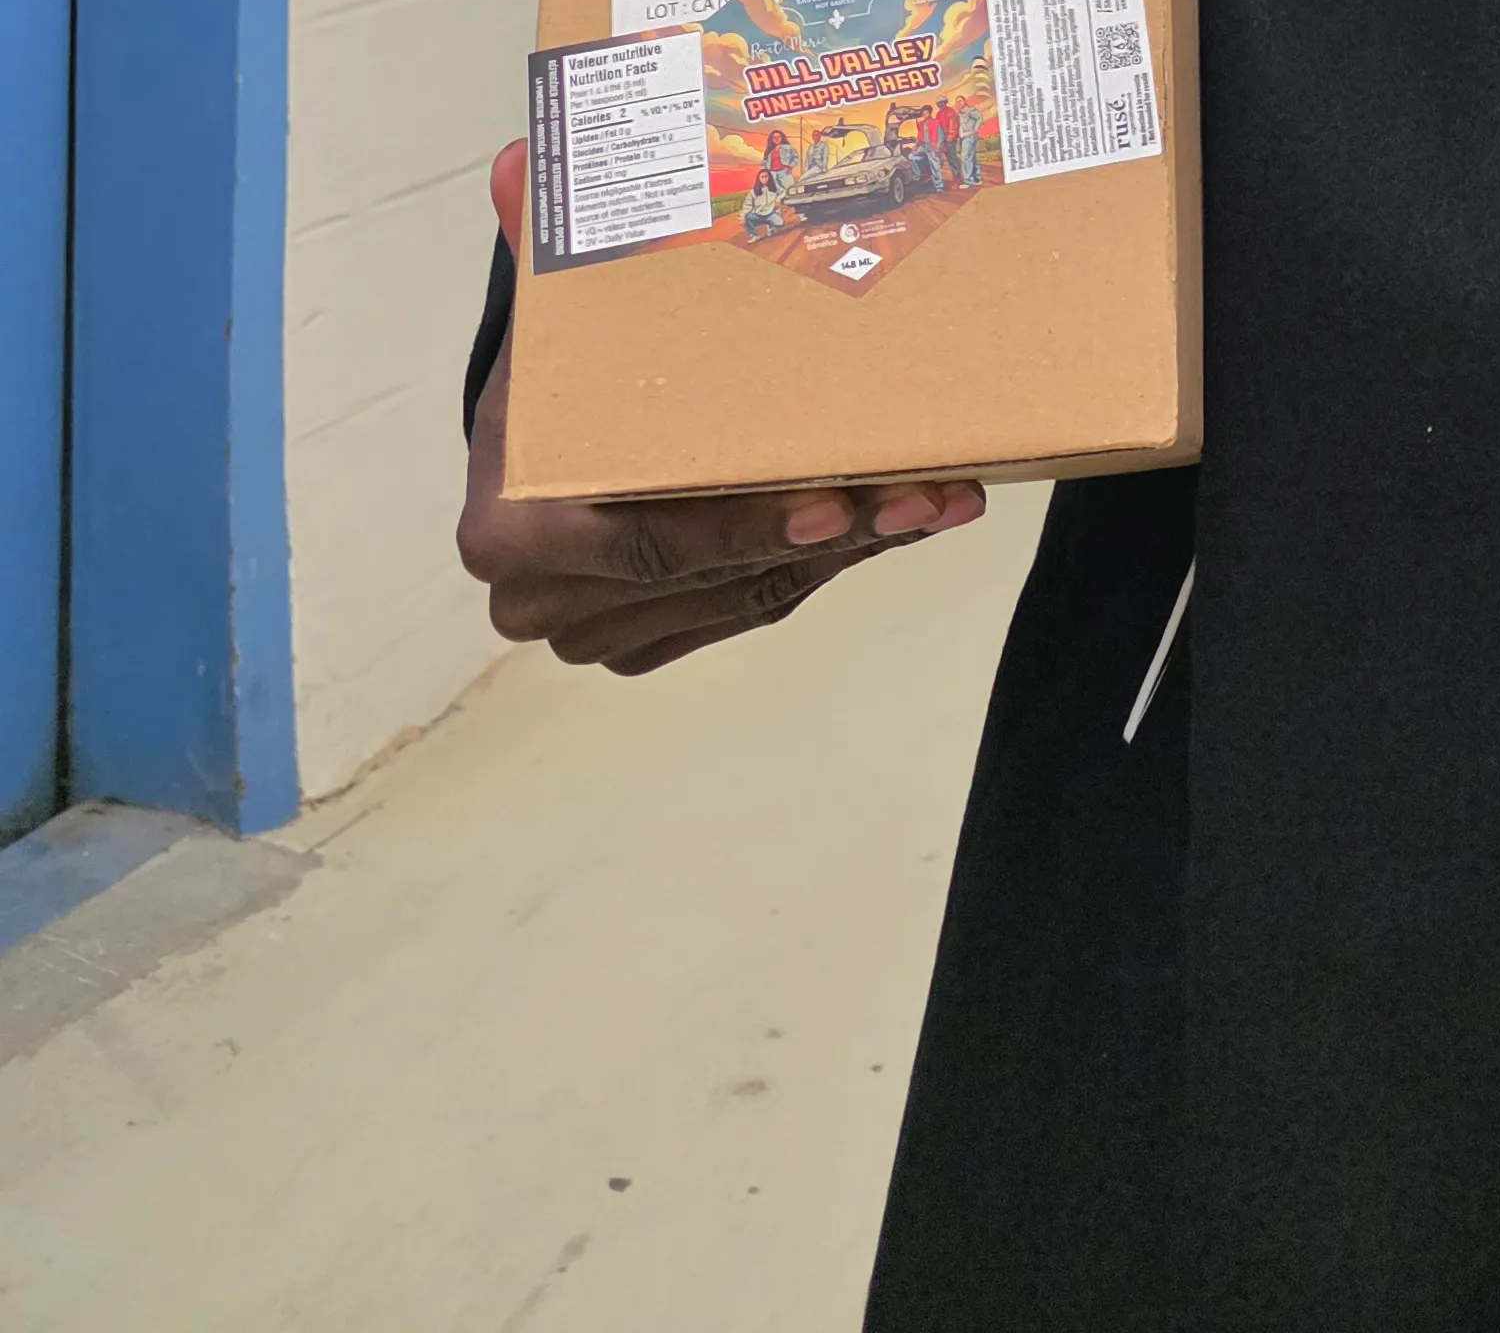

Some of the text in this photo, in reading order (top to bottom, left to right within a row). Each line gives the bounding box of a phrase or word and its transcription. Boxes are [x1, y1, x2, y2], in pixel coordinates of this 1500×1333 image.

[646, 2, 679, 20] LOT
[568, 42, 662, 70] Valeur nutritive
[745, 35, 935, 94] HILL VALLEY
[569, 59, 657, 87] Nutrition Facts
[744, 76, 878, 120] PINEAPPLE
[877, 64, 940, 95] HEAT
[570, 110, 611, 127] Calories
[620, 107, 626, 118] 2
